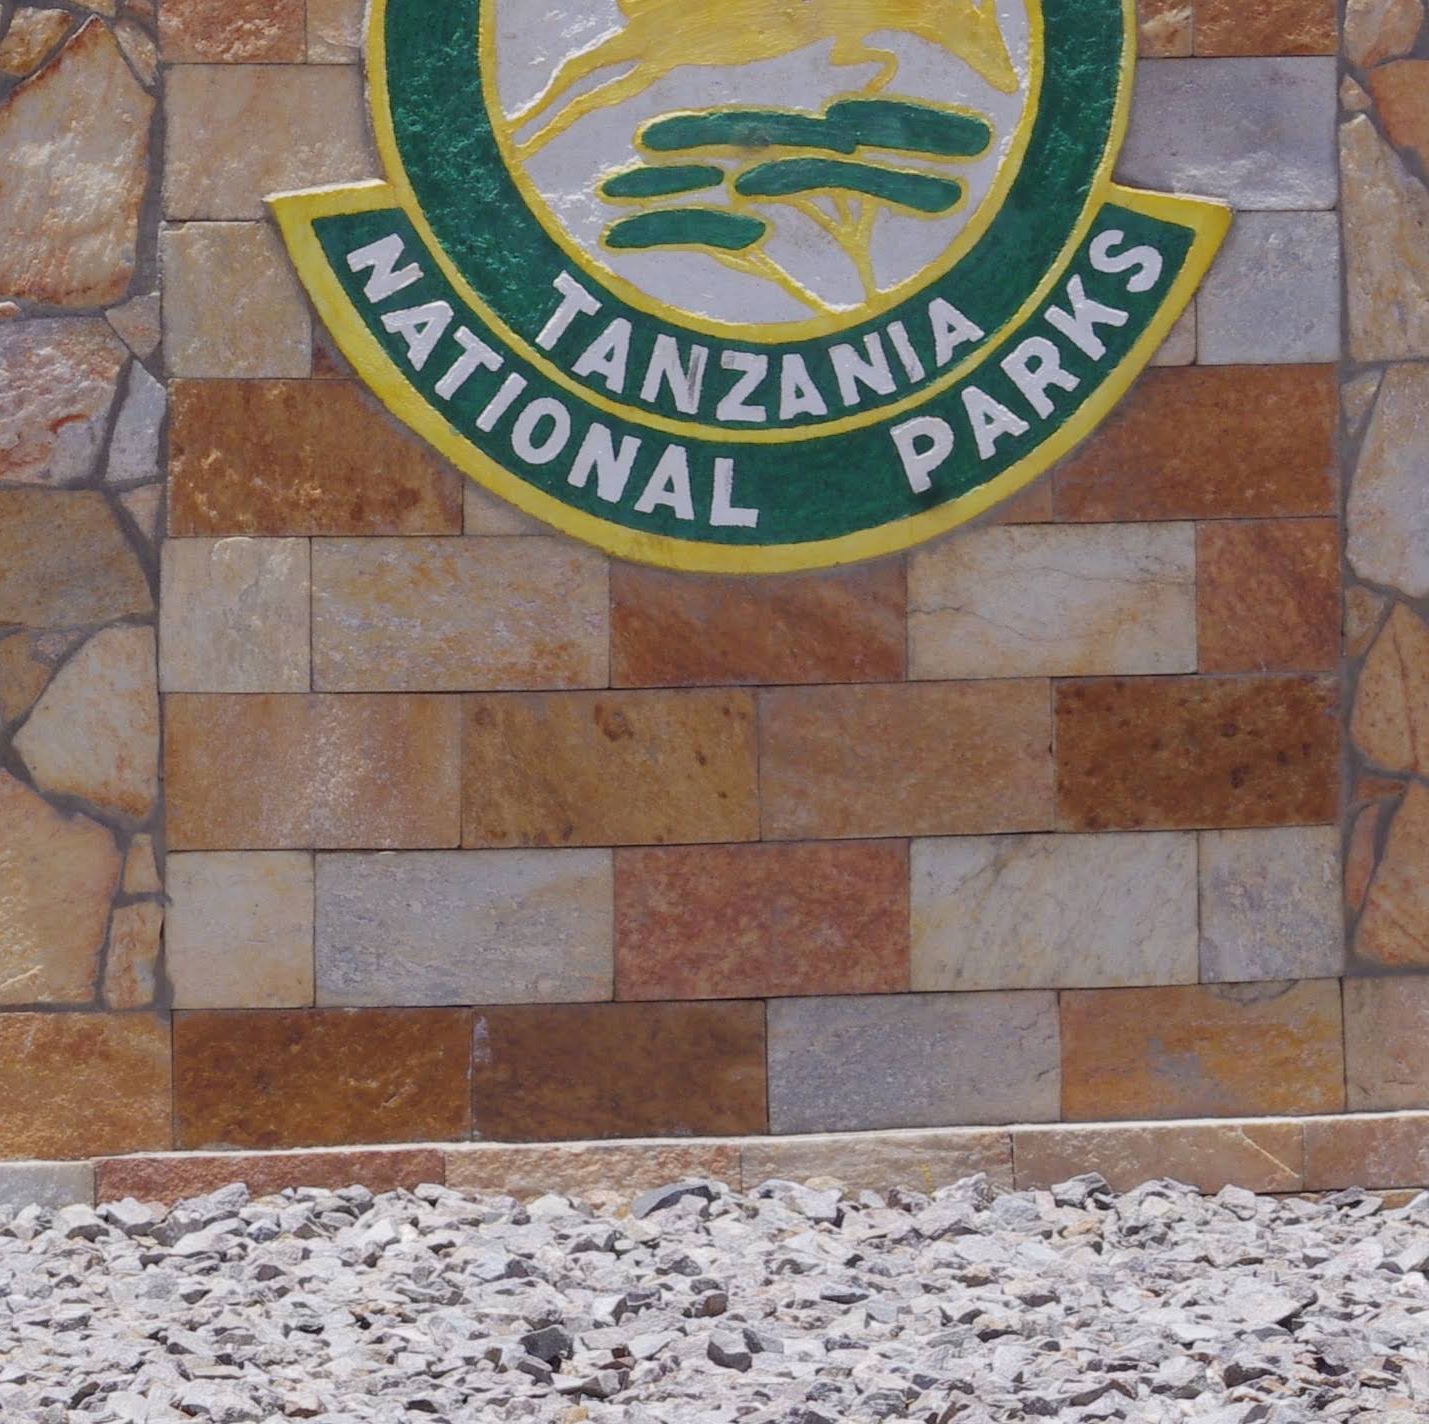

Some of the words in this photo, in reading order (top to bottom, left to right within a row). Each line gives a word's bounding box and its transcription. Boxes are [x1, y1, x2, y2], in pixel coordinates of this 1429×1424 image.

[346, 232, 760, 527] NATIONAL
[892, 228, 1164, 493] PARKS
[534, 271, 985, 422] TANZANIA
